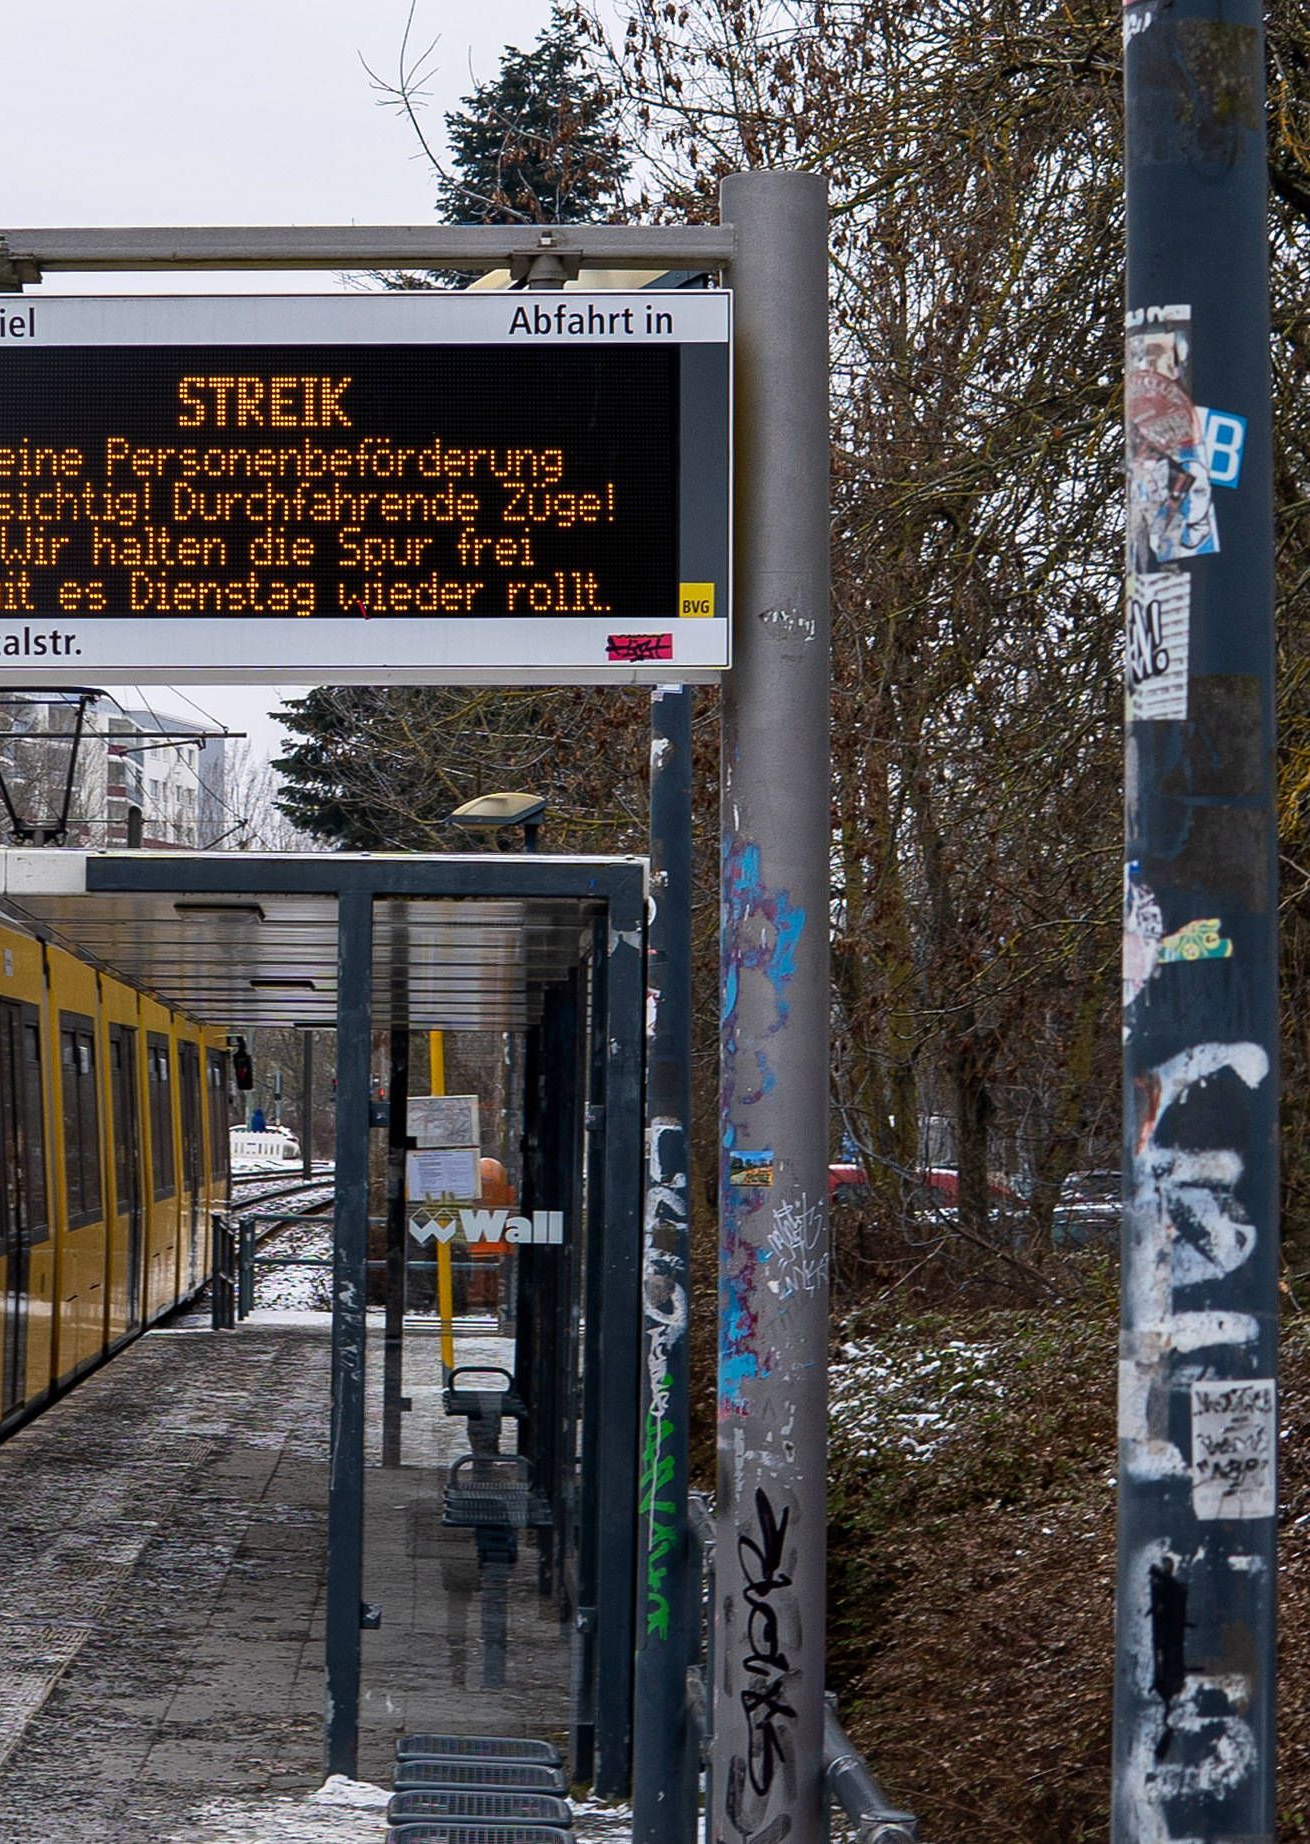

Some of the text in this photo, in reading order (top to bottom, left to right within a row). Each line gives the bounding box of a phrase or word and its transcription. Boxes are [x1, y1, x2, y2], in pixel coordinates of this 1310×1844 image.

[508, 304, 673, 335] Abfahrt in
[178, 376, 352, 427] STREIK
[106, 437, 563, 484] Personenbeförderung
[174, 481, 479, 521] Durchfahrende
[503, 481, 616, 527] Züge!
[0, 526, 535, 572] Wir halten die Spur frei
[59, 581, 107, 611] es
[131, 570, 315, 617] Dienstag
[338, 570, 484, 611] wieder
[508, 571, 612, 611] rollt.
[682, 600, 710, 614] BVG
[459, 1209, 564, 1245] Wall
